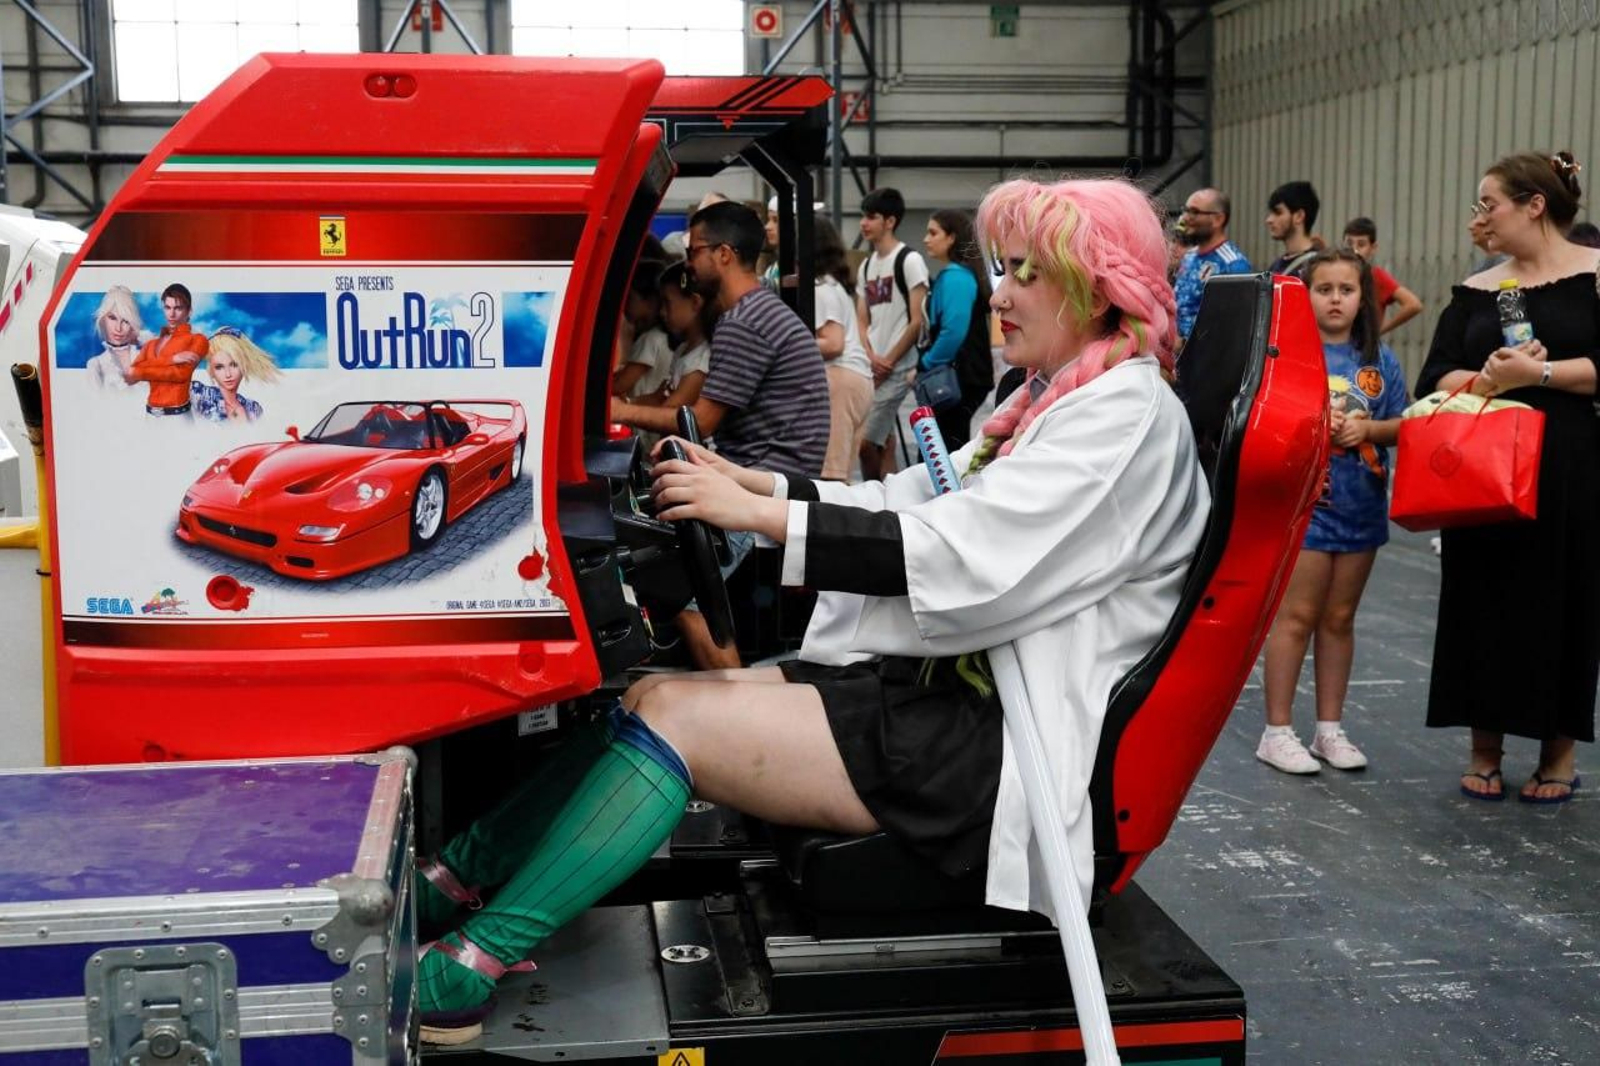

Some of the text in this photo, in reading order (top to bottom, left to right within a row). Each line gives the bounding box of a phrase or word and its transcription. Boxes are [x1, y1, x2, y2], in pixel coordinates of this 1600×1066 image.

[335, 275, 395, 291] SEGA PRESENTS
[336, 291, 496, 370] OutRun 2
[86, 597, 134, 615] SEGA
